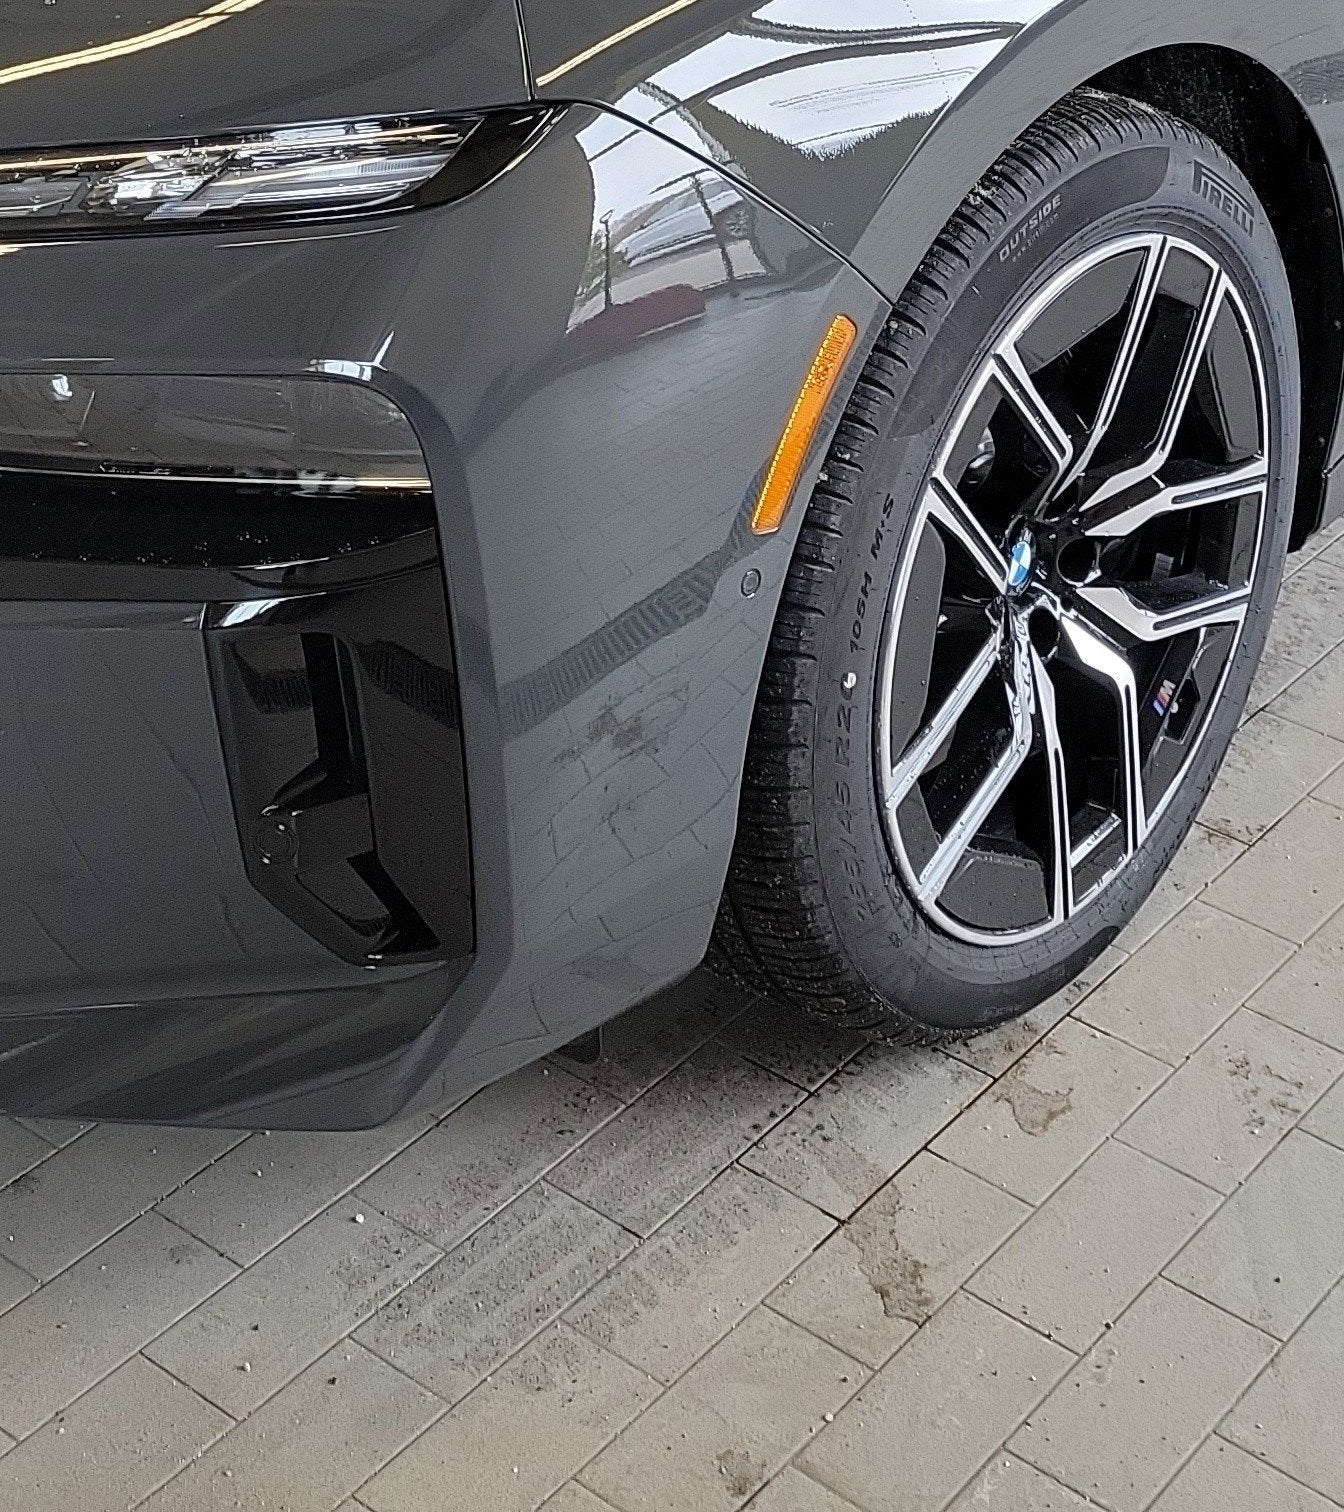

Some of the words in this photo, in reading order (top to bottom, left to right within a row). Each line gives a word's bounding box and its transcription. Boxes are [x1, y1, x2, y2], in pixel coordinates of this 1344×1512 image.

[999, 193, 1062, 263] OUTSIDE
[1192, 158, 1255, 239] PIRELLI
[849, 570, 873, 653] 105H
